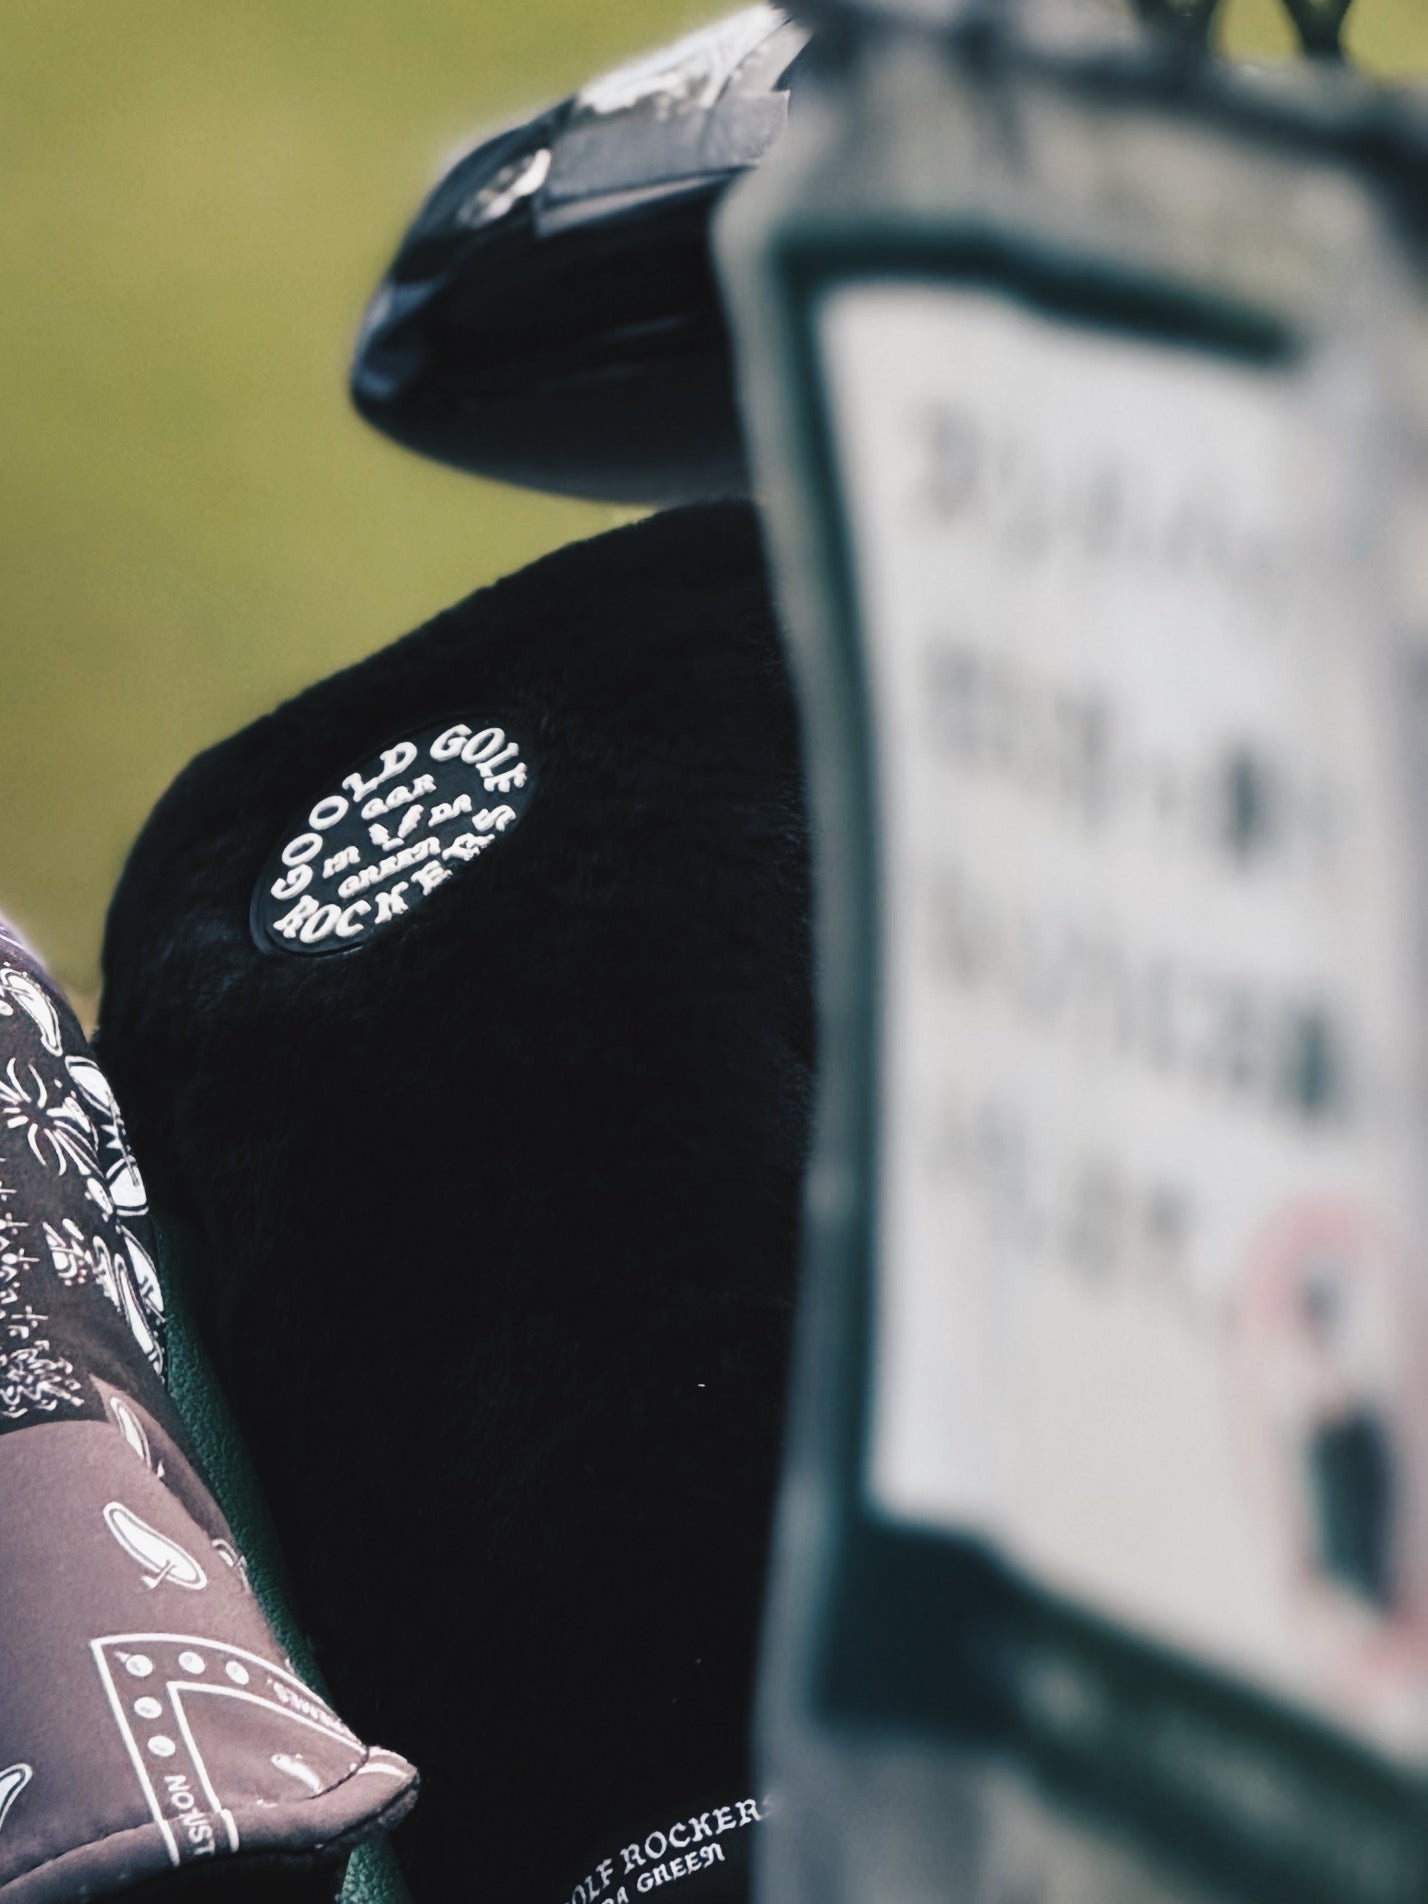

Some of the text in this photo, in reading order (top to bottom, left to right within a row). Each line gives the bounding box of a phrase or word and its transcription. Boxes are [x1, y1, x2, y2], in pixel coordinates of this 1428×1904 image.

[270, 723, 528, 901] GOOLD GOLF
[272, 803, 517, 945] ROCKERS
[635, 1842, 726, 1893] GREEN
